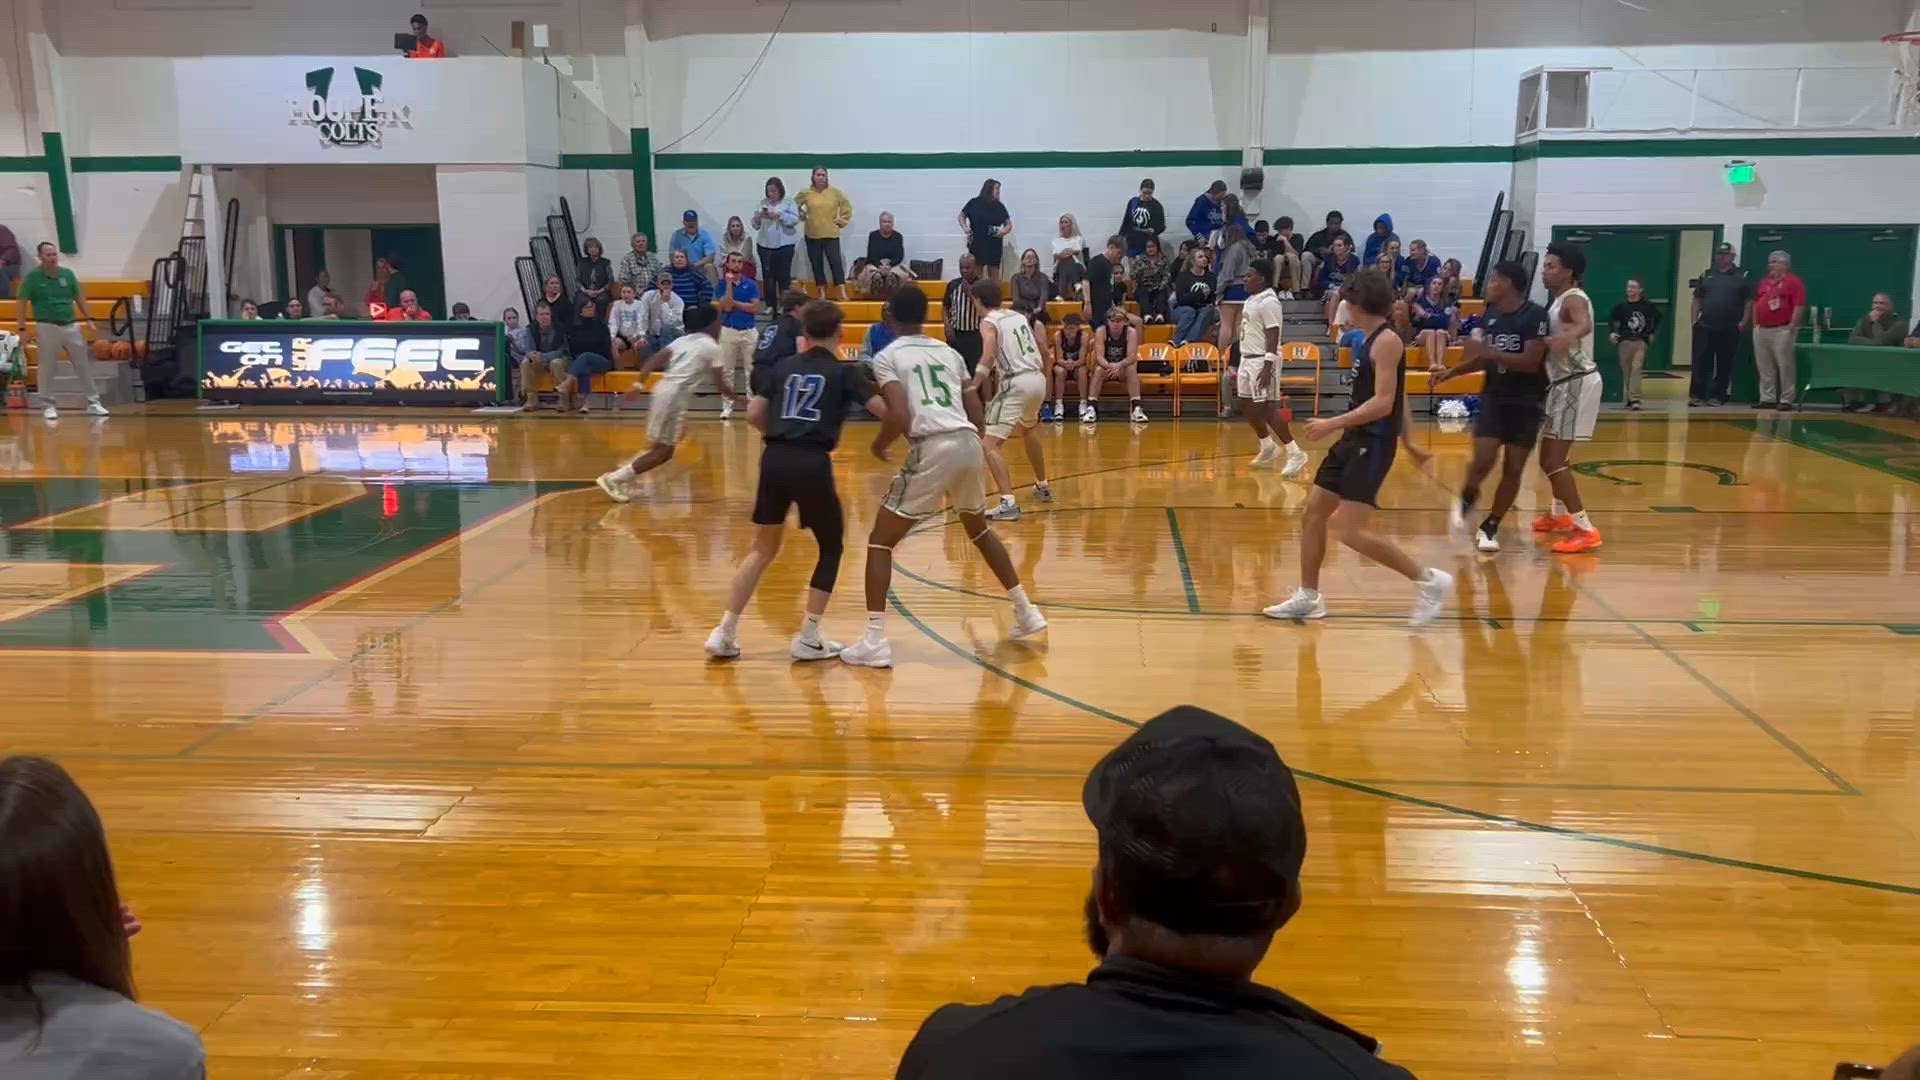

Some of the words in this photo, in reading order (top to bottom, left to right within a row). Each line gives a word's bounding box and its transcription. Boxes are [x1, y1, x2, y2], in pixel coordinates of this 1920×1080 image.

[320, 121, 381, 141] COLTS
[310, 338, 485, 372] FEET
[780, 373, 826, 422] 12
[912, 363, 952, 408] 15
